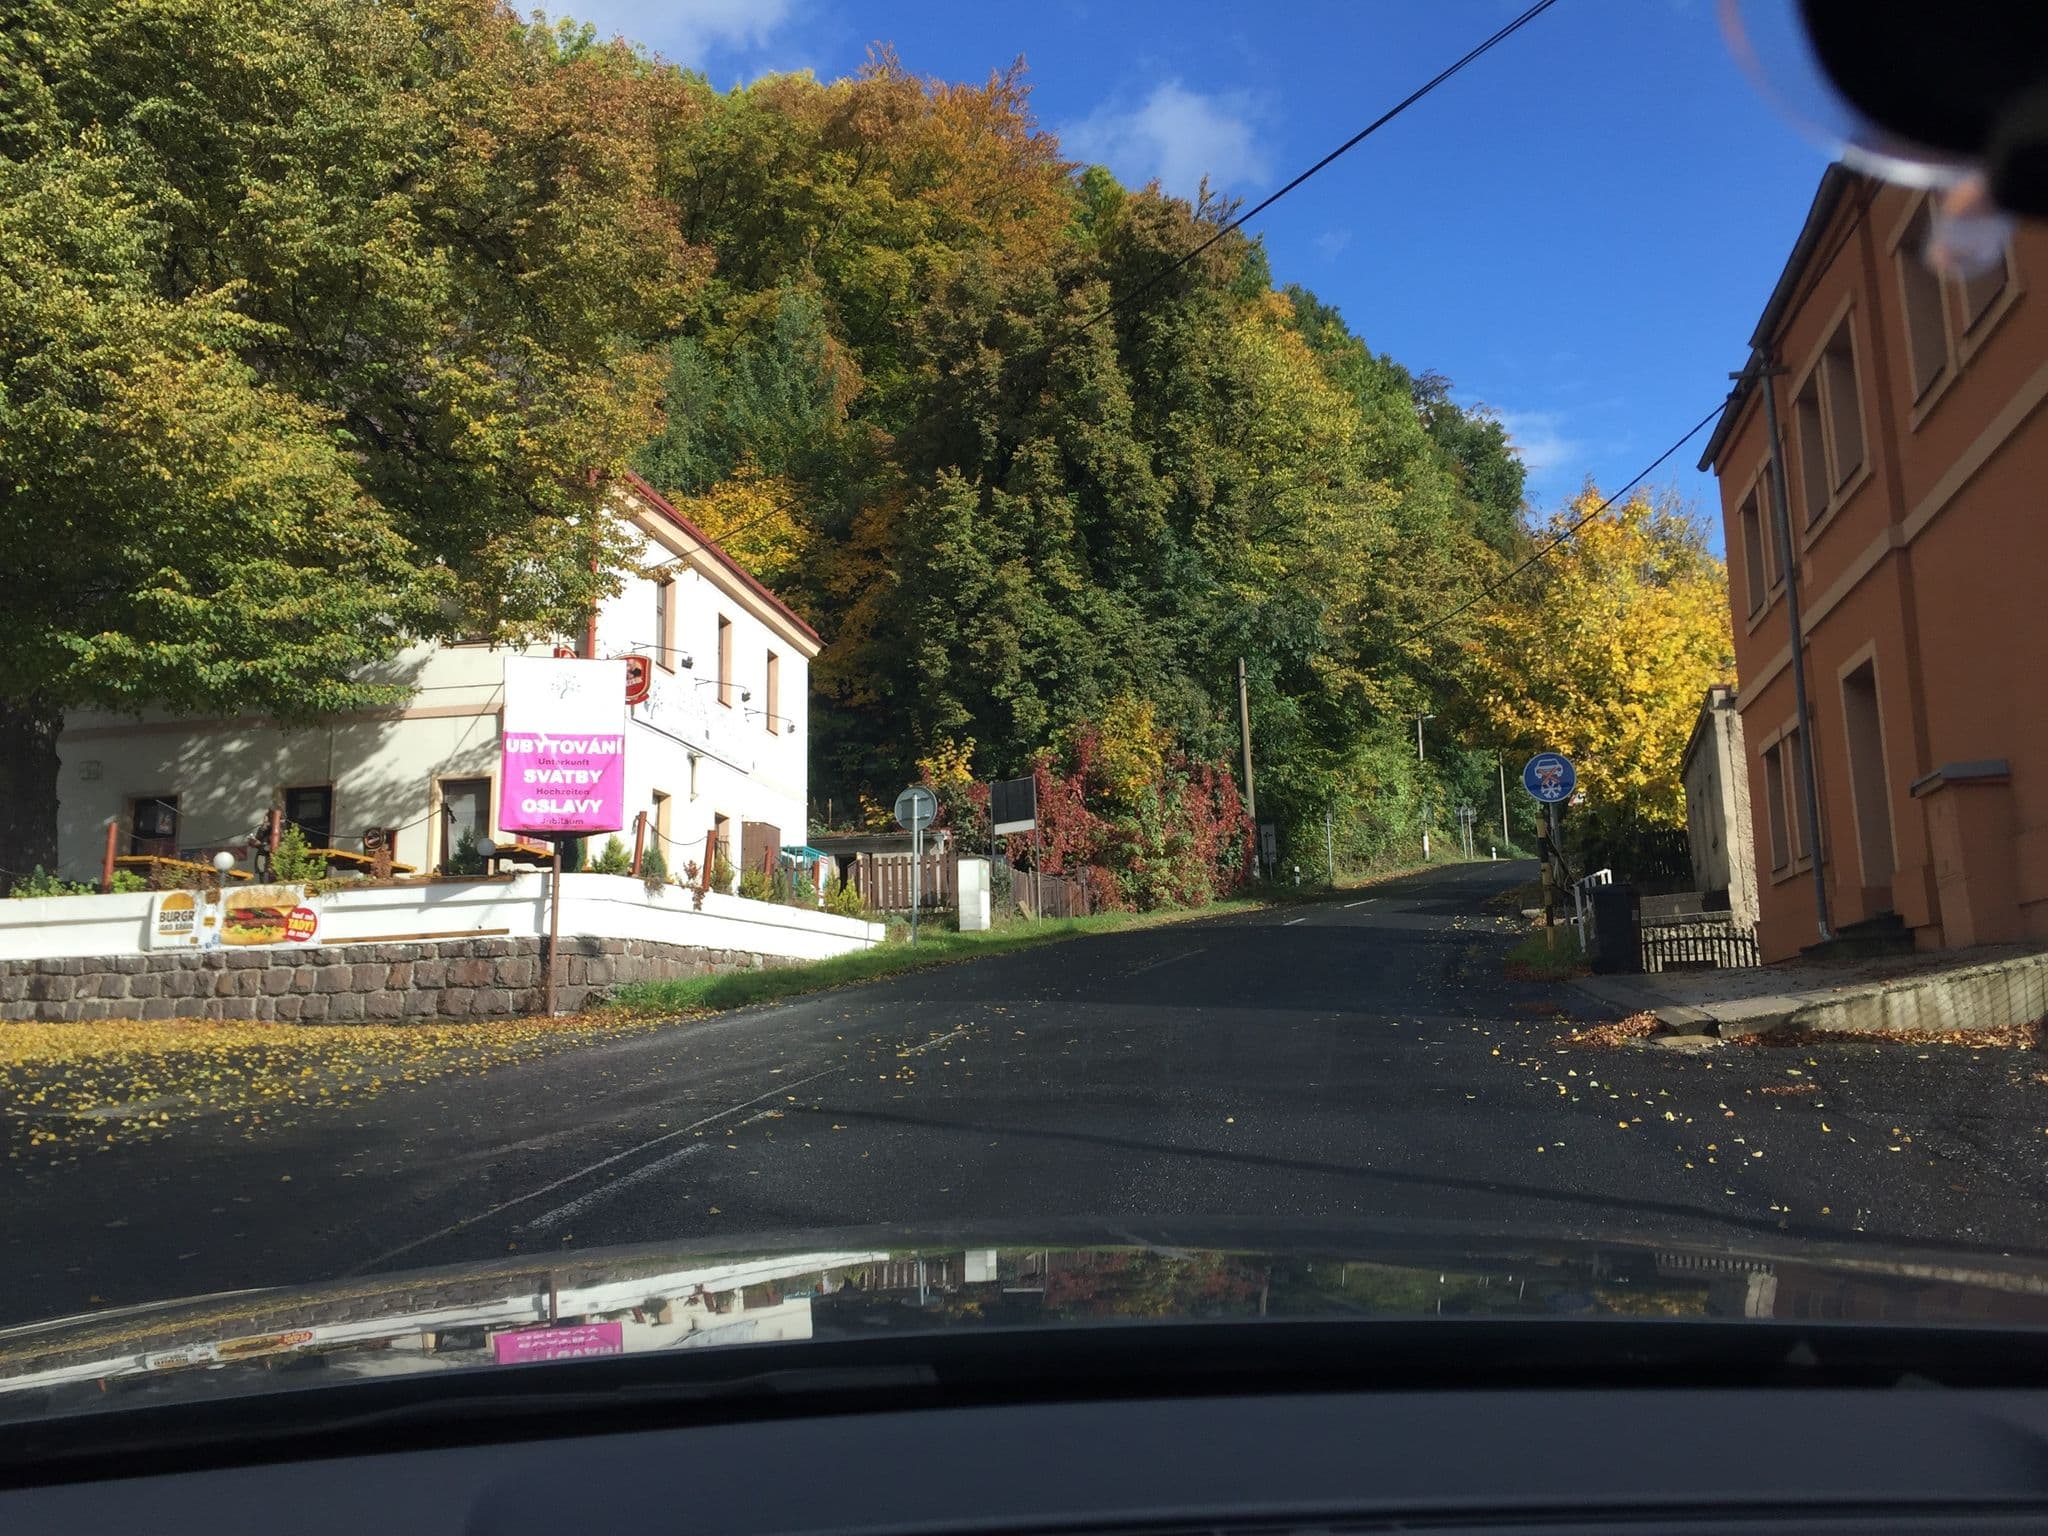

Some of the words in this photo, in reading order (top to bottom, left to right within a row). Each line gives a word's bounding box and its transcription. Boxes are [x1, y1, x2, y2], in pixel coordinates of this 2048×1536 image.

[523, 769, 603, 784] SVATBY
[522, 799, 603, 814] OSLAVY
[159, 910, 195, 923] BURGR
